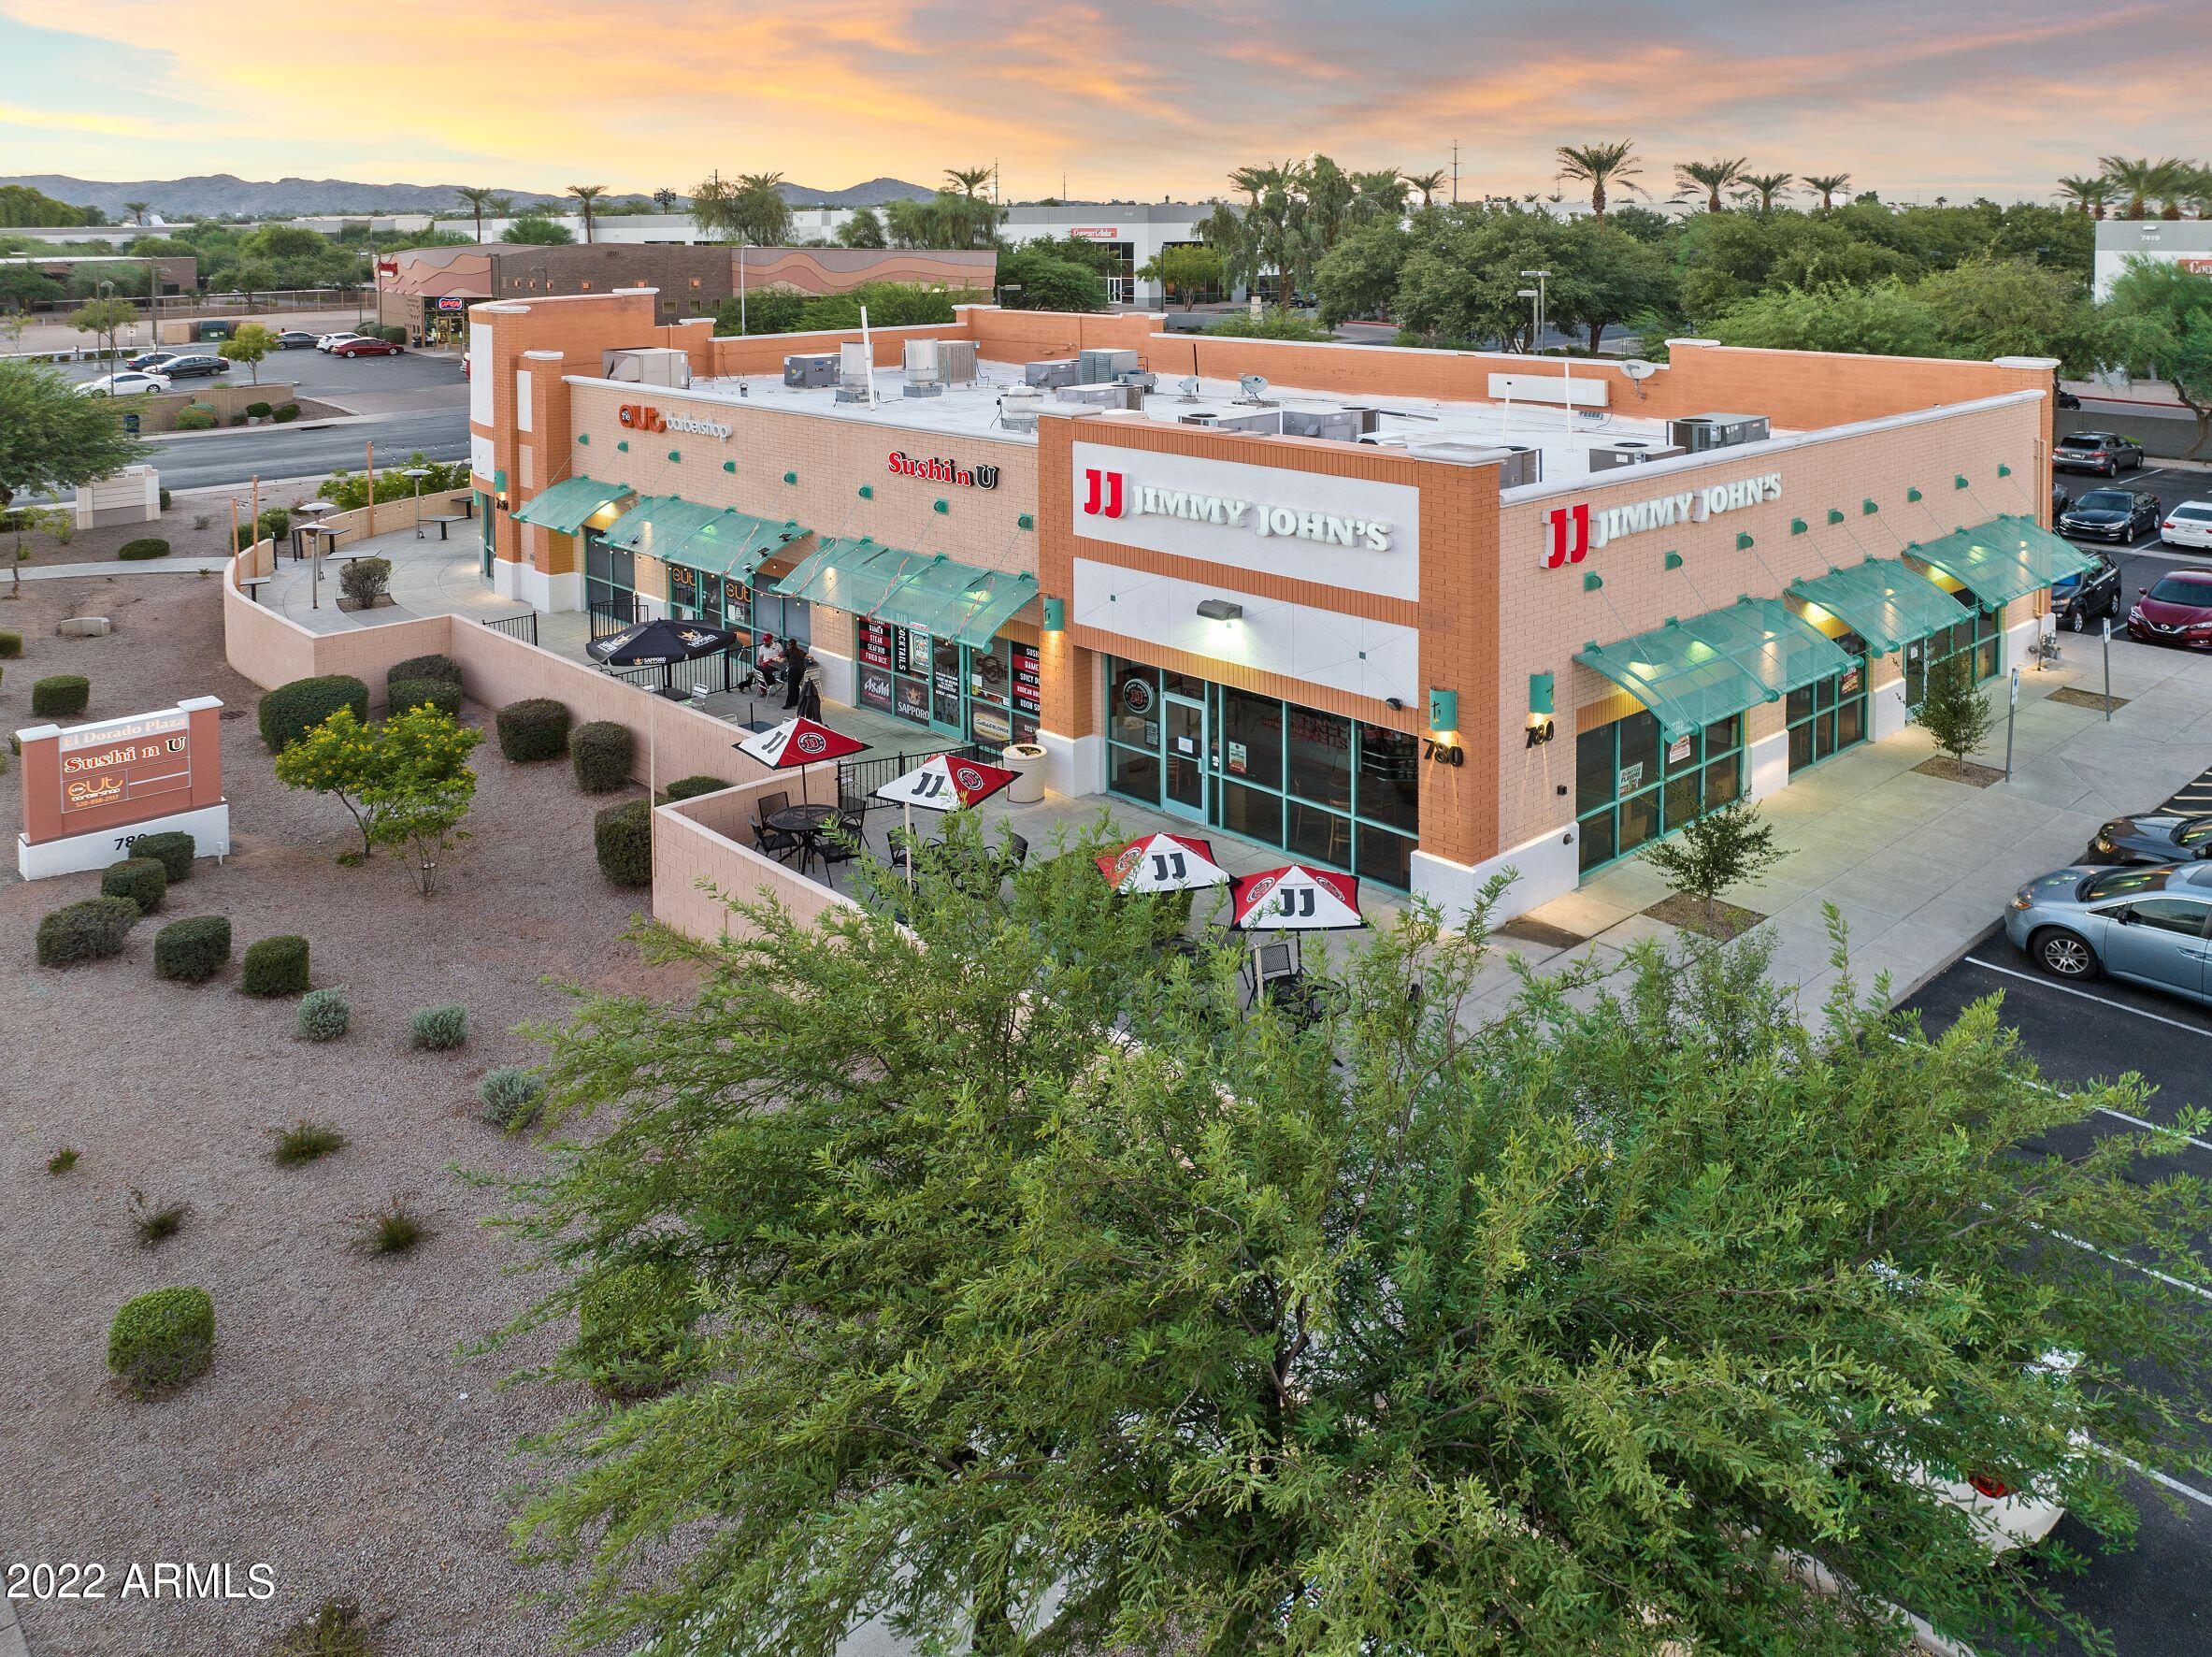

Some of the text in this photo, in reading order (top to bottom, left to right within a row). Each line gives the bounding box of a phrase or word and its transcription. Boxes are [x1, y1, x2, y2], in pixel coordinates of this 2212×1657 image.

[440, 300, 461, 309] OPEN
[667, 411, 733, 443] barbershop
[888, 451, 999, 490] Sushi n U
[1084, 468, 1396, 552] JJ JIMMY JOHN'S
[1540, 472, 1783, 569] JJ JIMMY JOHN'S
[868, 643, 885, 655] SEAFOOD
[869, 634, 883, 644] STEAK
[1026, 648, 1040, 658] SUSH
[864, 677, 889, 698] Asahi
[898, 701, 929, 721] SAPPORO
[63, 717, 186, 747] El Dorado Plaza
[762, 730, 787, 754] JJ
[1525, 720, 1554, 748] 780
[64, 746, 136, 773] Sushi
[165, 737, 186, 753] U
[1423, 737, 1463, 767] 780
[71, 787, 121, 802] barbershop
[911, 771, 945, 798] JJ
[1151, 852, 1186, 882] JJ
[1279, 888, 1315, 917] JJ
